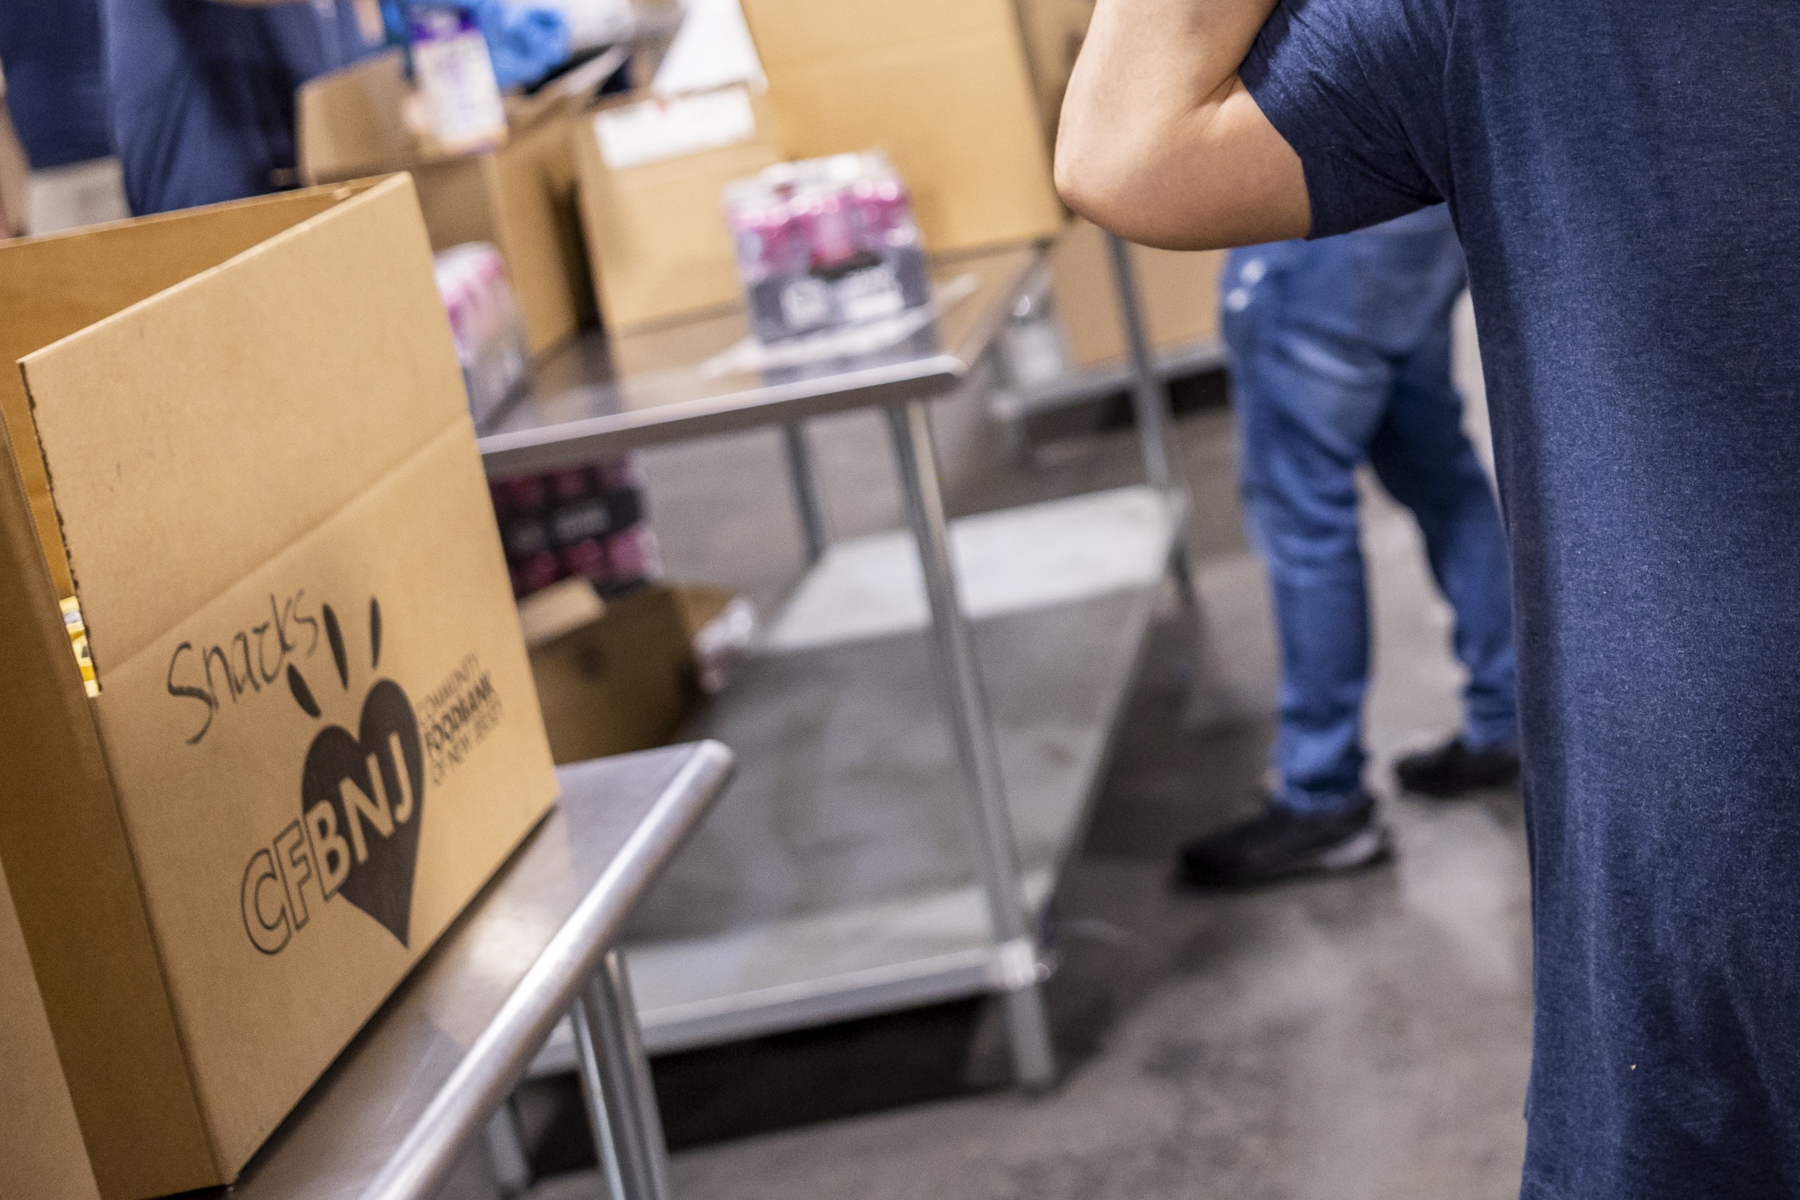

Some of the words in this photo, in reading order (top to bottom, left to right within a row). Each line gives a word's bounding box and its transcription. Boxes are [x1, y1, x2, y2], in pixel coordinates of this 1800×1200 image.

[167, 589, 319, 745] Snacks
[424, 671, 496, 762] FOODBANK
[241, 730, 413, 955] CFBNJ
